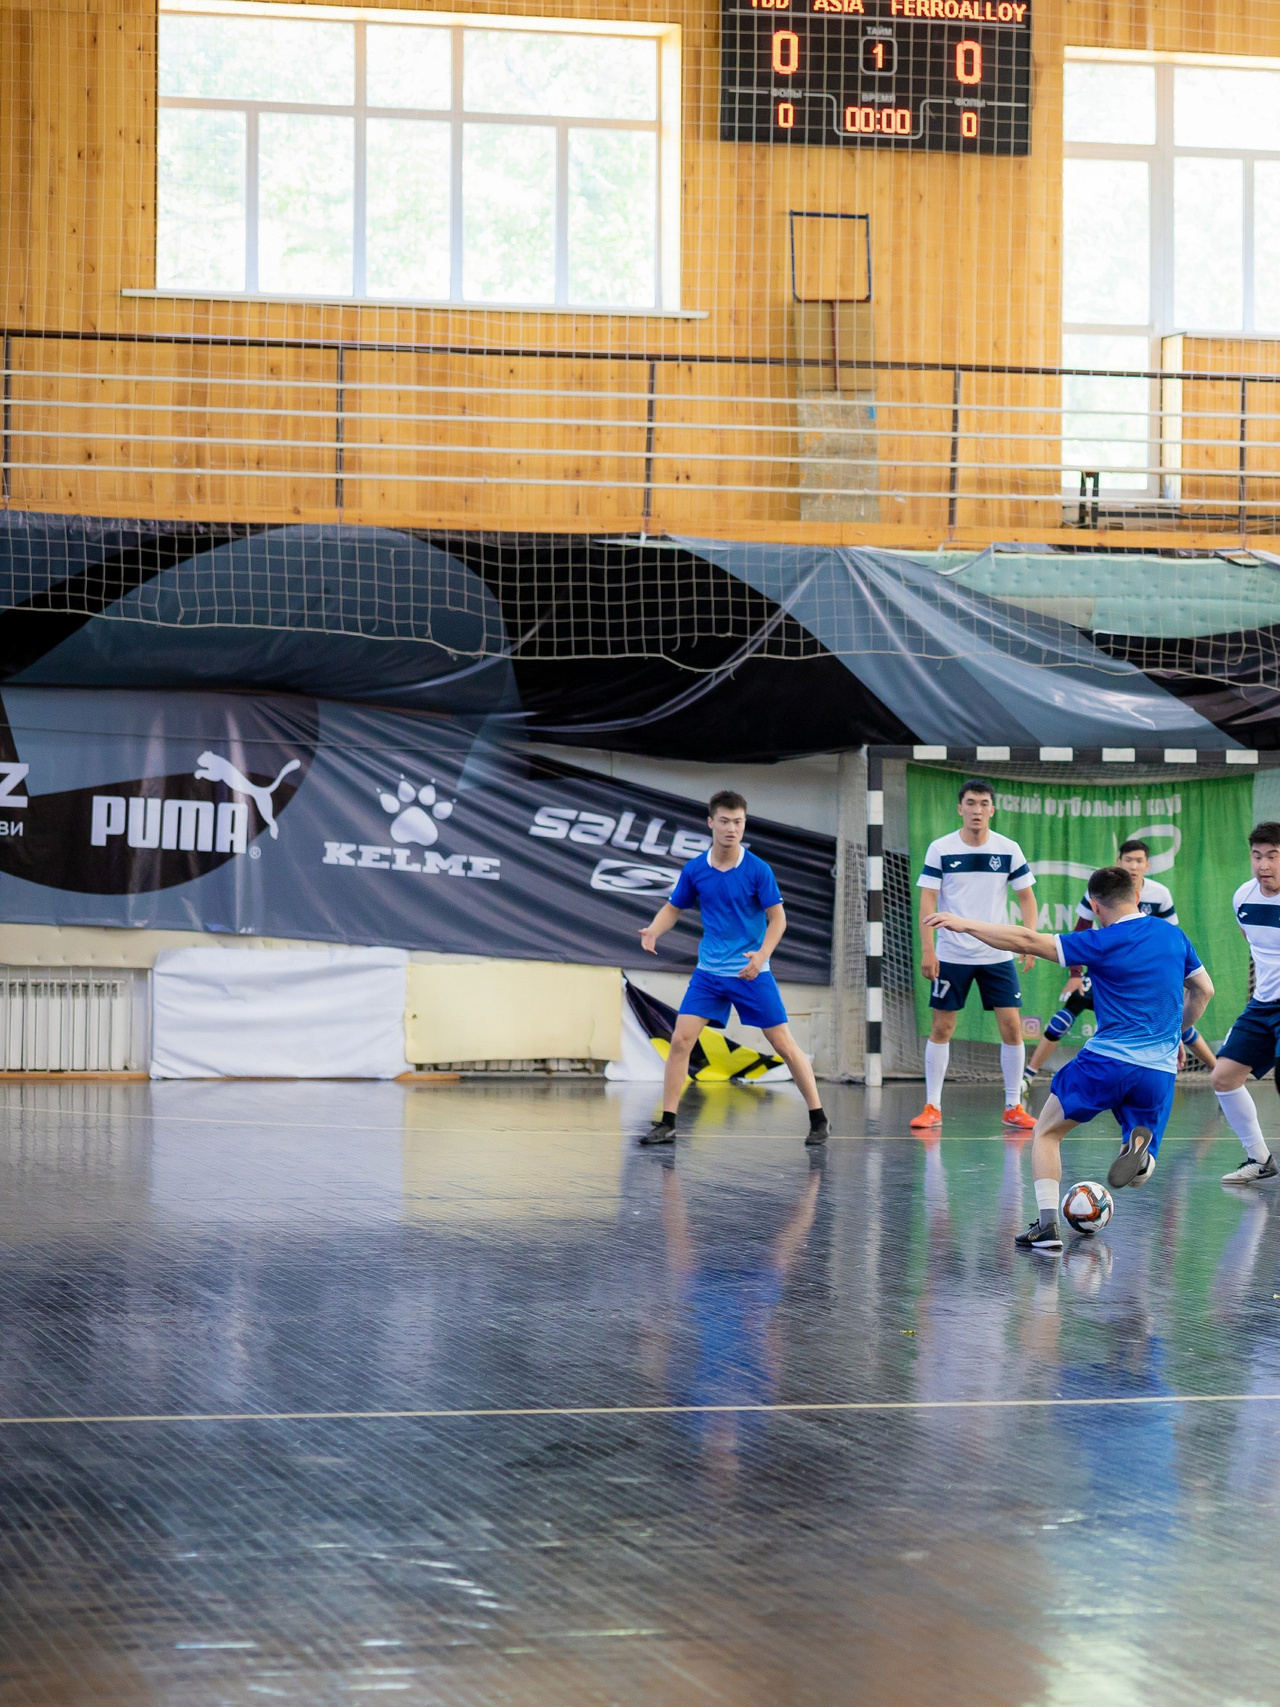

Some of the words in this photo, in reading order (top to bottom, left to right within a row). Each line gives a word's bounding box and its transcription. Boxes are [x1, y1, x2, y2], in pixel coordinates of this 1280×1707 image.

[891, 0, 1027, 22] FERROALLOY
[772, 30, 799, 75] 0
[872, 42, 884, 69] 1
[956, 39, 982, 85] 0
[778, 102, 794, 128] 0
[845, 106, 911, 134] 00:00
[962, 111, 977, 138] 0
[90, 795, 249, 854] PUMA
[322, 841, 501, 881] KELME
[932, 977, 951, 999] 17
